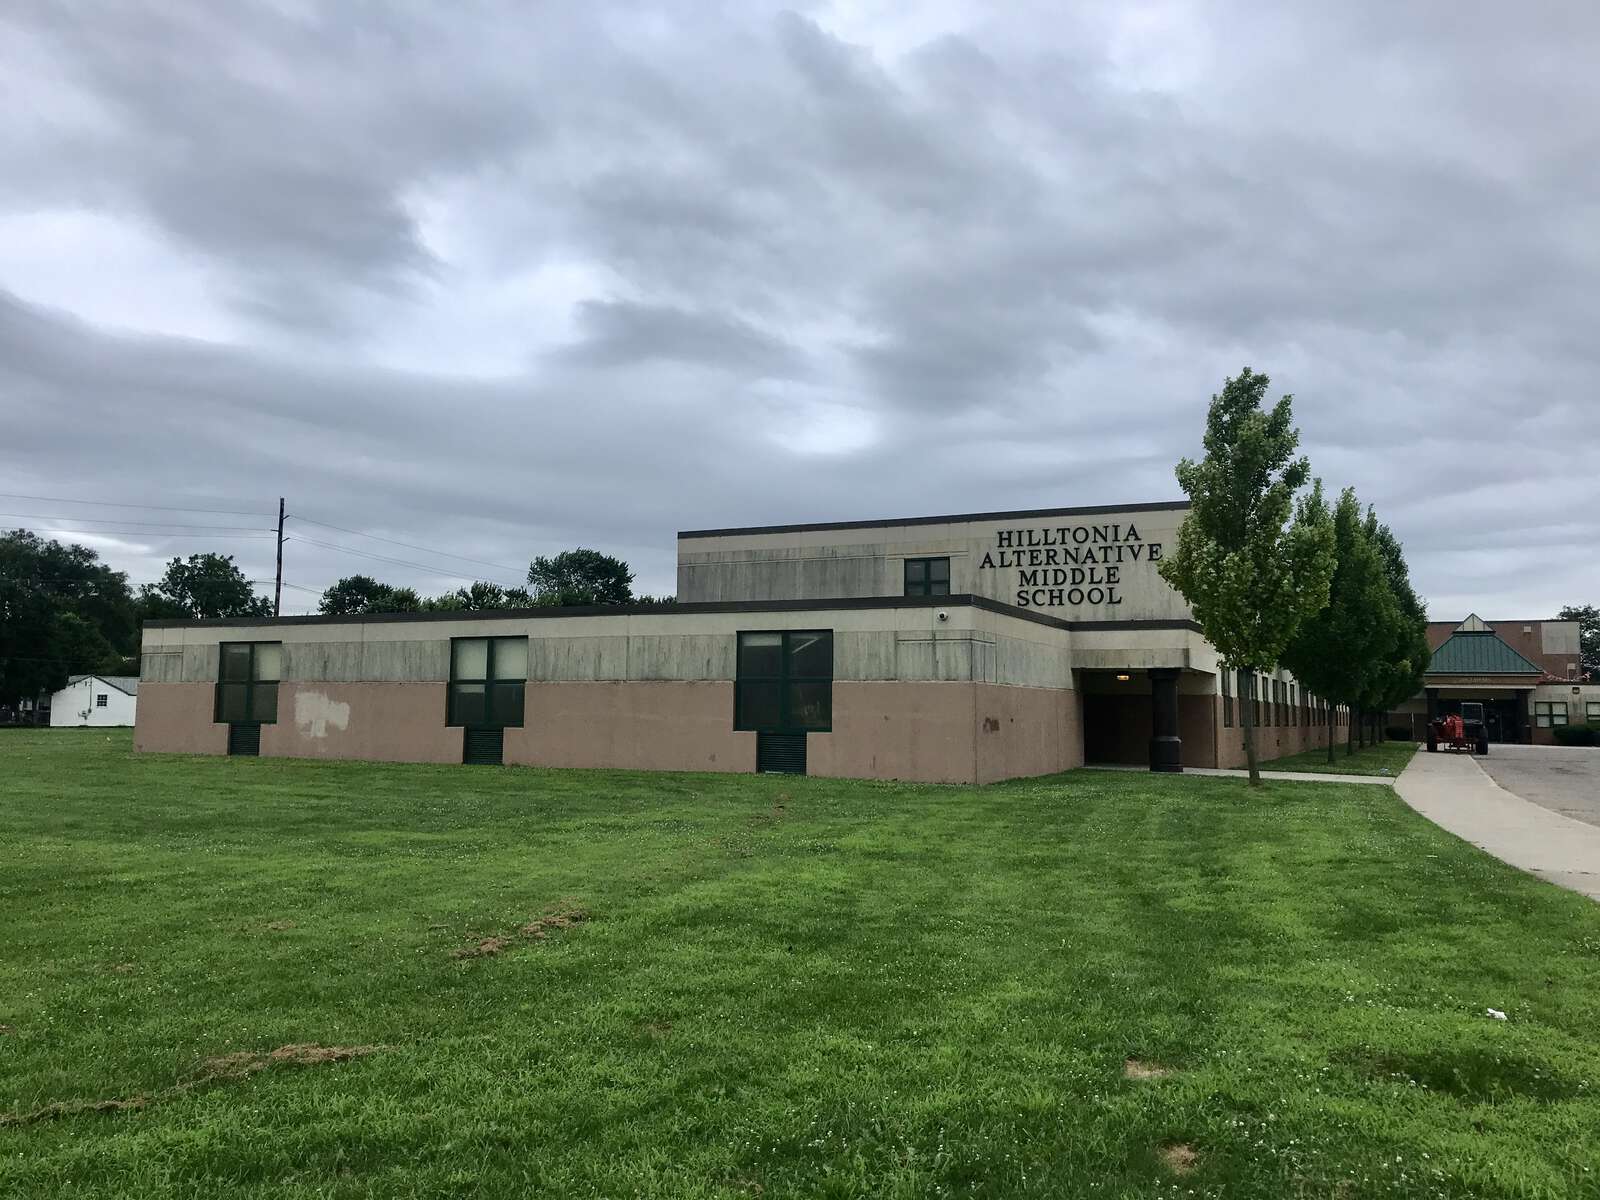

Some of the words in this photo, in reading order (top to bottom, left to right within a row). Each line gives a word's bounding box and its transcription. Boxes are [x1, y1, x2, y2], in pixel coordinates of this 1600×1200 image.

[997, 523, 1142, 548] HILLTONIA
[979, 543, 1163, 569] ALTERNATIVE
[1018, 566, 1120, 587] MIDDLE
[1017, 587, 1122, 607] SCHOOL
